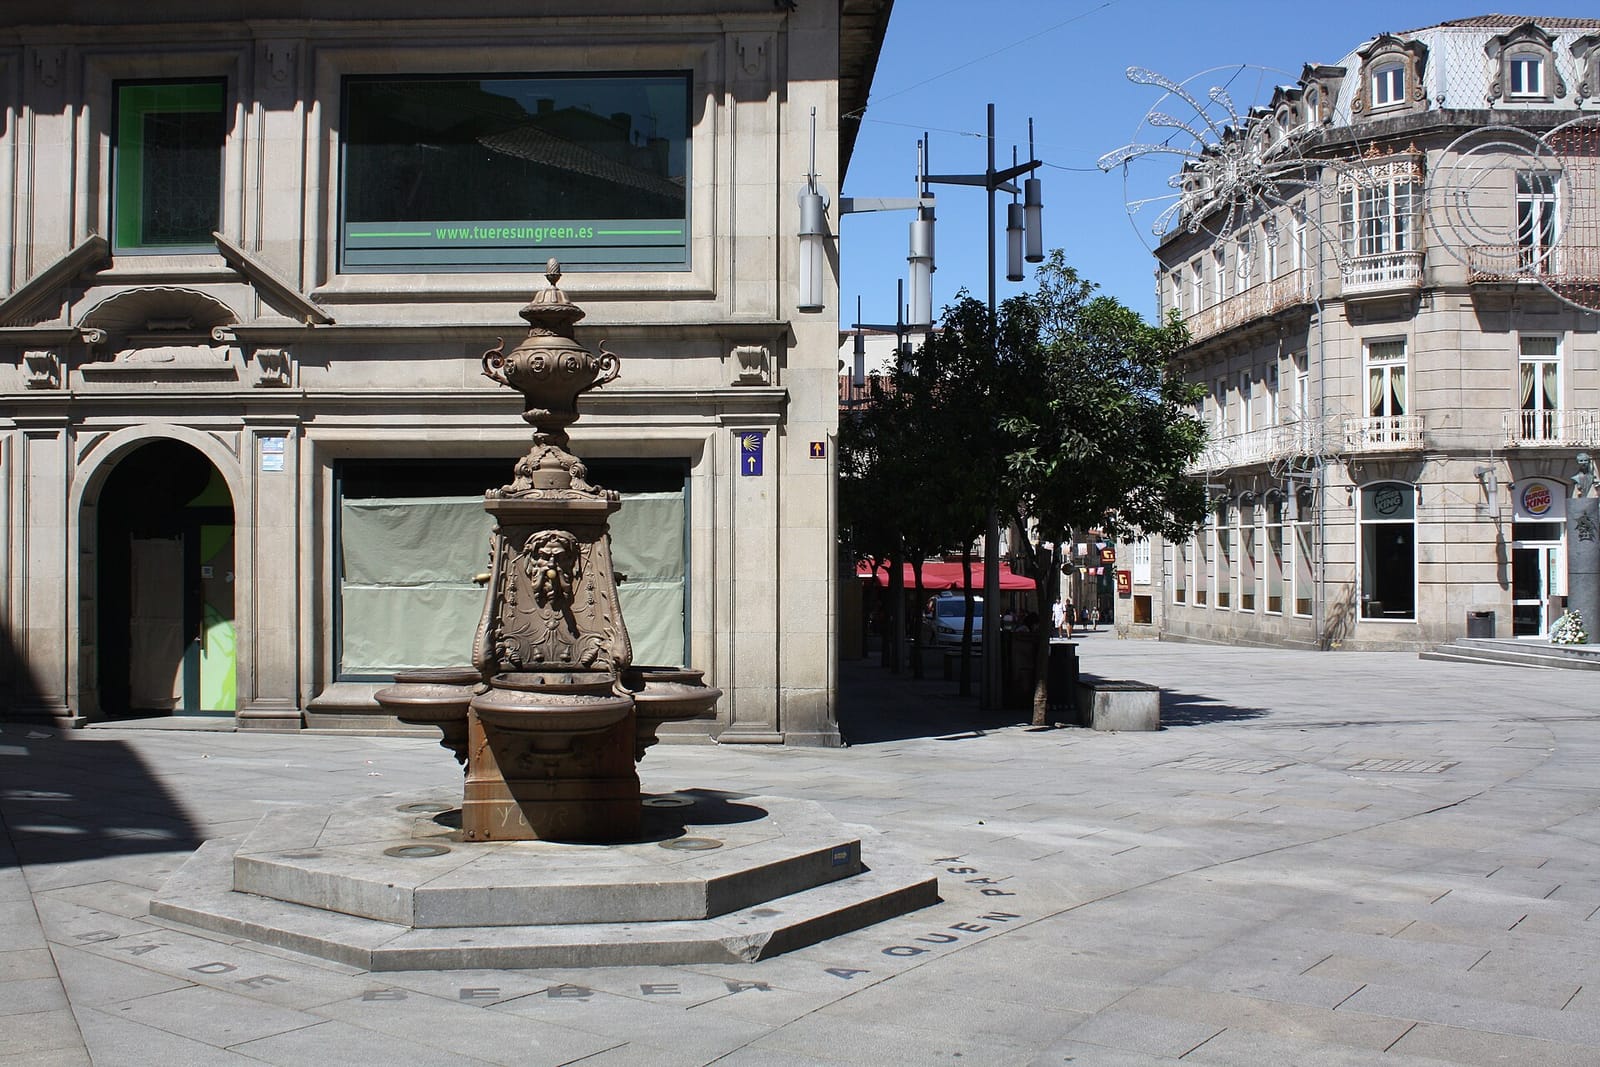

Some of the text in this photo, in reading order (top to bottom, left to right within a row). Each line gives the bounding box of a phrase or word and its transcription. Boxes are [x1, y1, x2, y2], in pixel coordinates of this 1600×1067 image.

[436, 226, 593, 242] www.tueresungreen.es
[1376, 495, 1401, 511] KING
[1525, 489, 1549, 501] BURGER
[1526, 496, 1551, 508] KING
[934, 856, 1017, 896] PASA
[881, 911, 1022, 957] QUEN
[188, 961, 291, 988] DE
[824, 967, 871, 980] A
[362, 981, 772, 1001] BEBER
